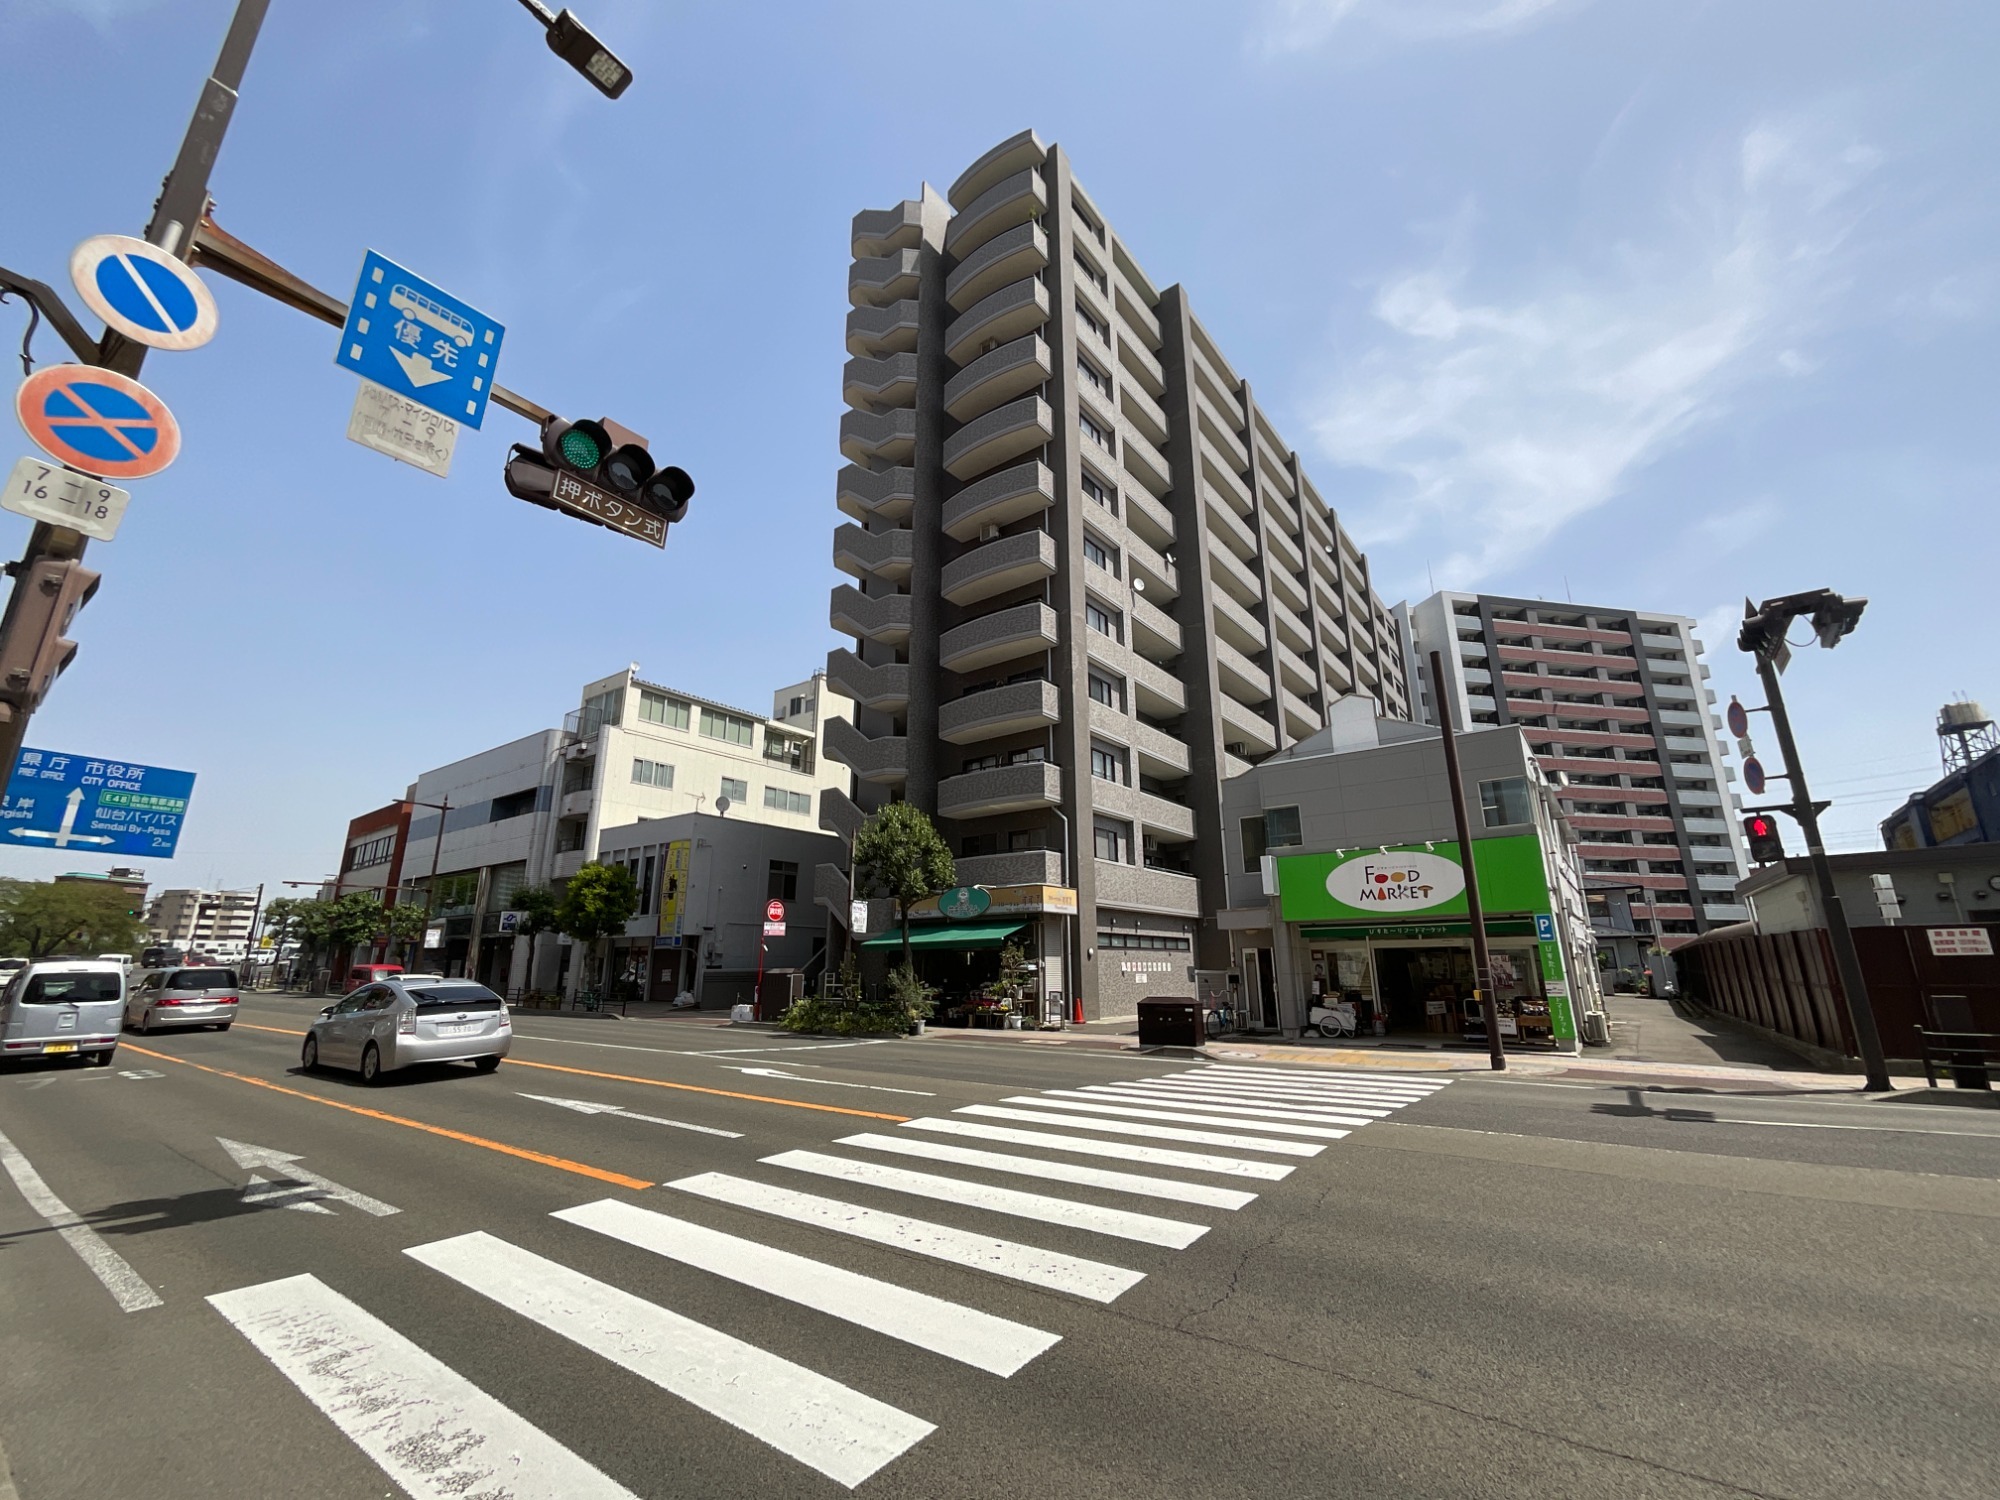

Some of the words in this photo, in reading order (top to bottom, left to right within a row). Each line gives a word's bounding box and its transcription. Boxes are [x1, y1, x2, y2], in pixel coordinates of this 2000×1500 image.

[393, 319, 459, 368] 優先
[426, 426, 436, 440] 9
[38, 466, 51, 480] 7
[98, 489, 111, 502] 9
[24, 480, 48, 499] 16
[84, 501, 108, 519] 18
[560, 478, 662, 539] 押ボタン式
[20, 752, 71, 770] 県庁
[84, 761, 146, 781] 市役所
[40, 770, 66, 781] OFFICE
[81, 775, 105, 786] CITY
[107, 779, 142, 791] OFFICE
[105, 793, 129, 804] E48
[95, 807, 177, 826] 仙台バイパス
[90, 820, 127, 832] Sendai
[128, 822, 171, 836] By-Pass
[1365, 865, 1420, 884] FOOD
[1359, 884, 1434, 901] MARKET
[1539, 919, 1549, 931] P
